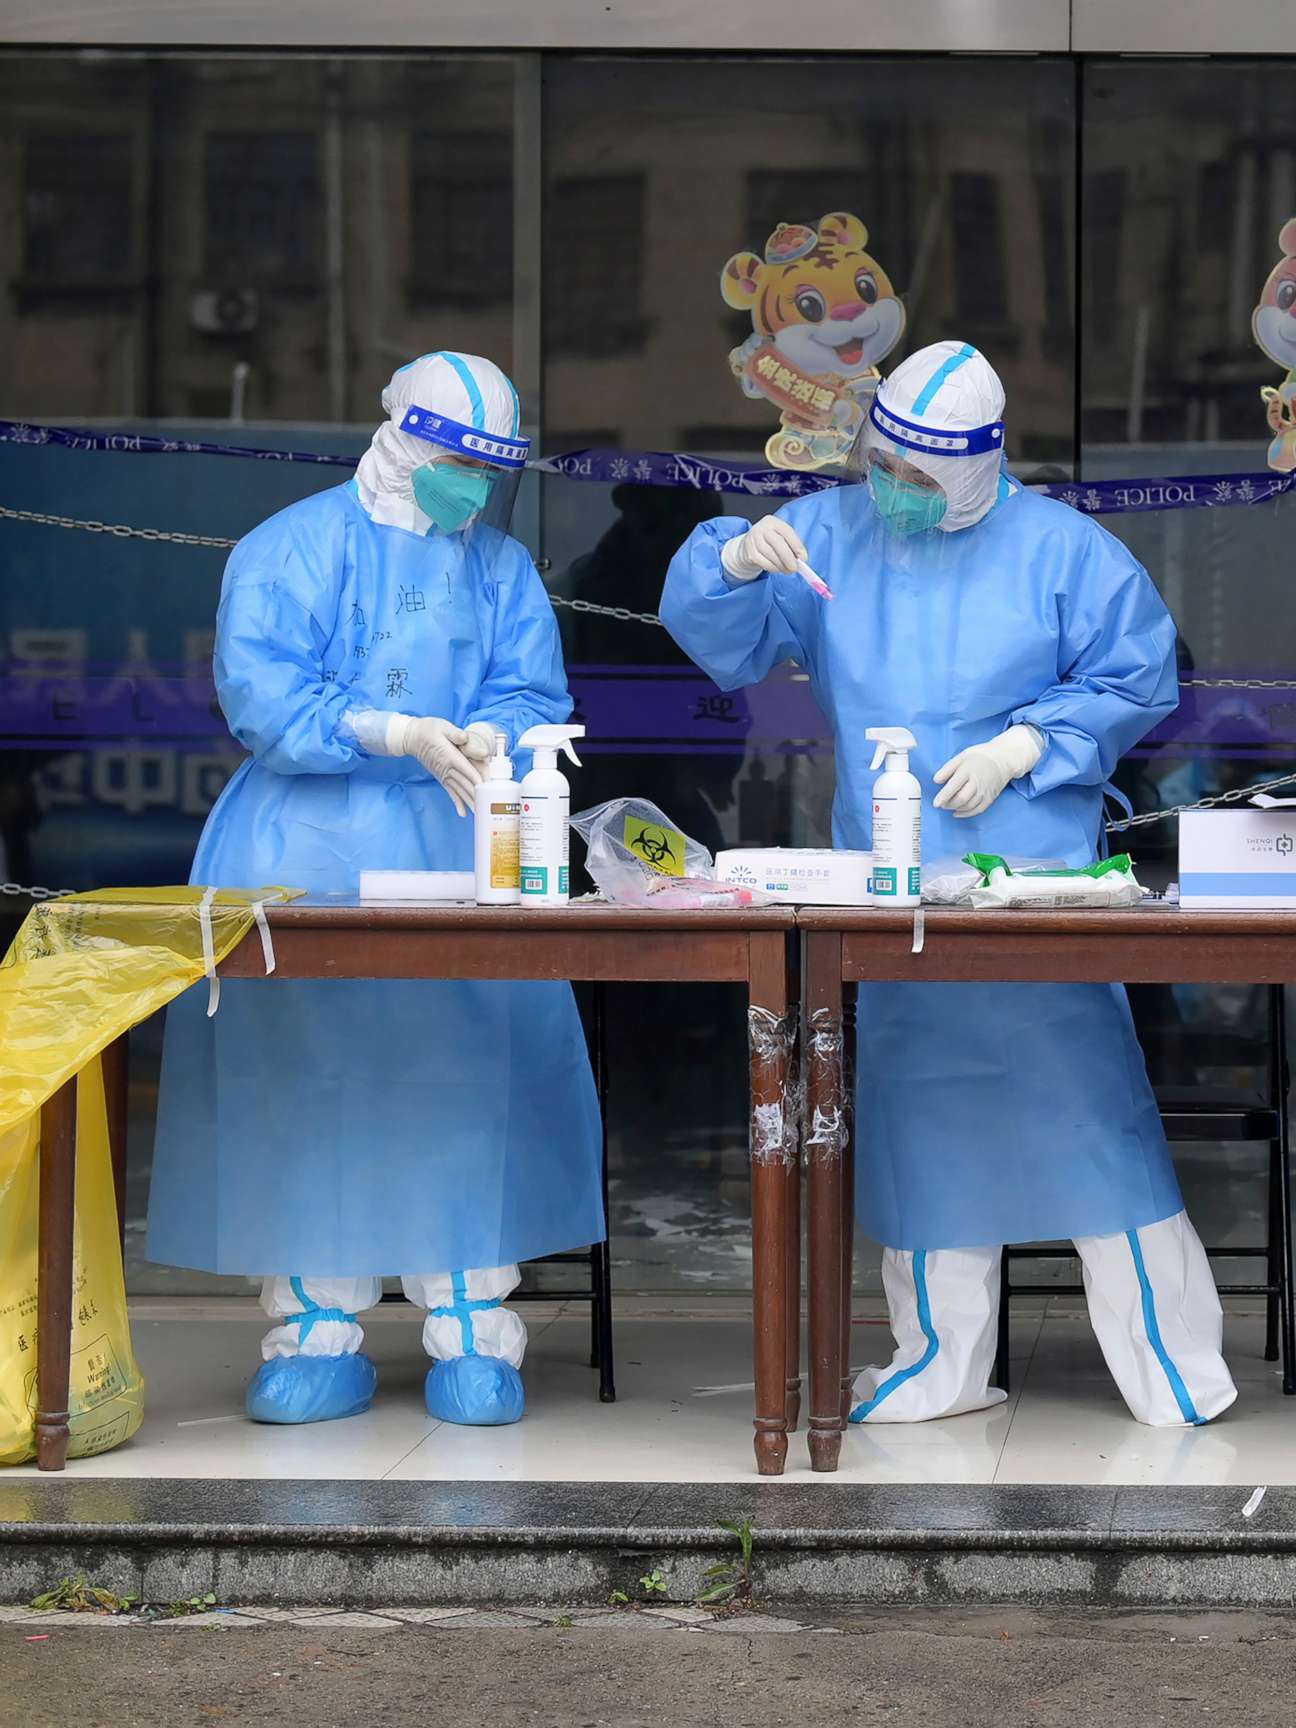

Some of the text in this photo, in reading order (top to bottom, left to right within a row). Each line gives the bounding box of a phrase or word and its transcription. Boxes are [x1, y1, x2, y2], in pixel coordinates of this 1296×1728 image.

[609, 458, 652, 480] 警察
[666, 462, 745, 488] POLICE
[1115, 486, 1195, 506] POLICE
[1213, 480, 1256, 501] 警察
